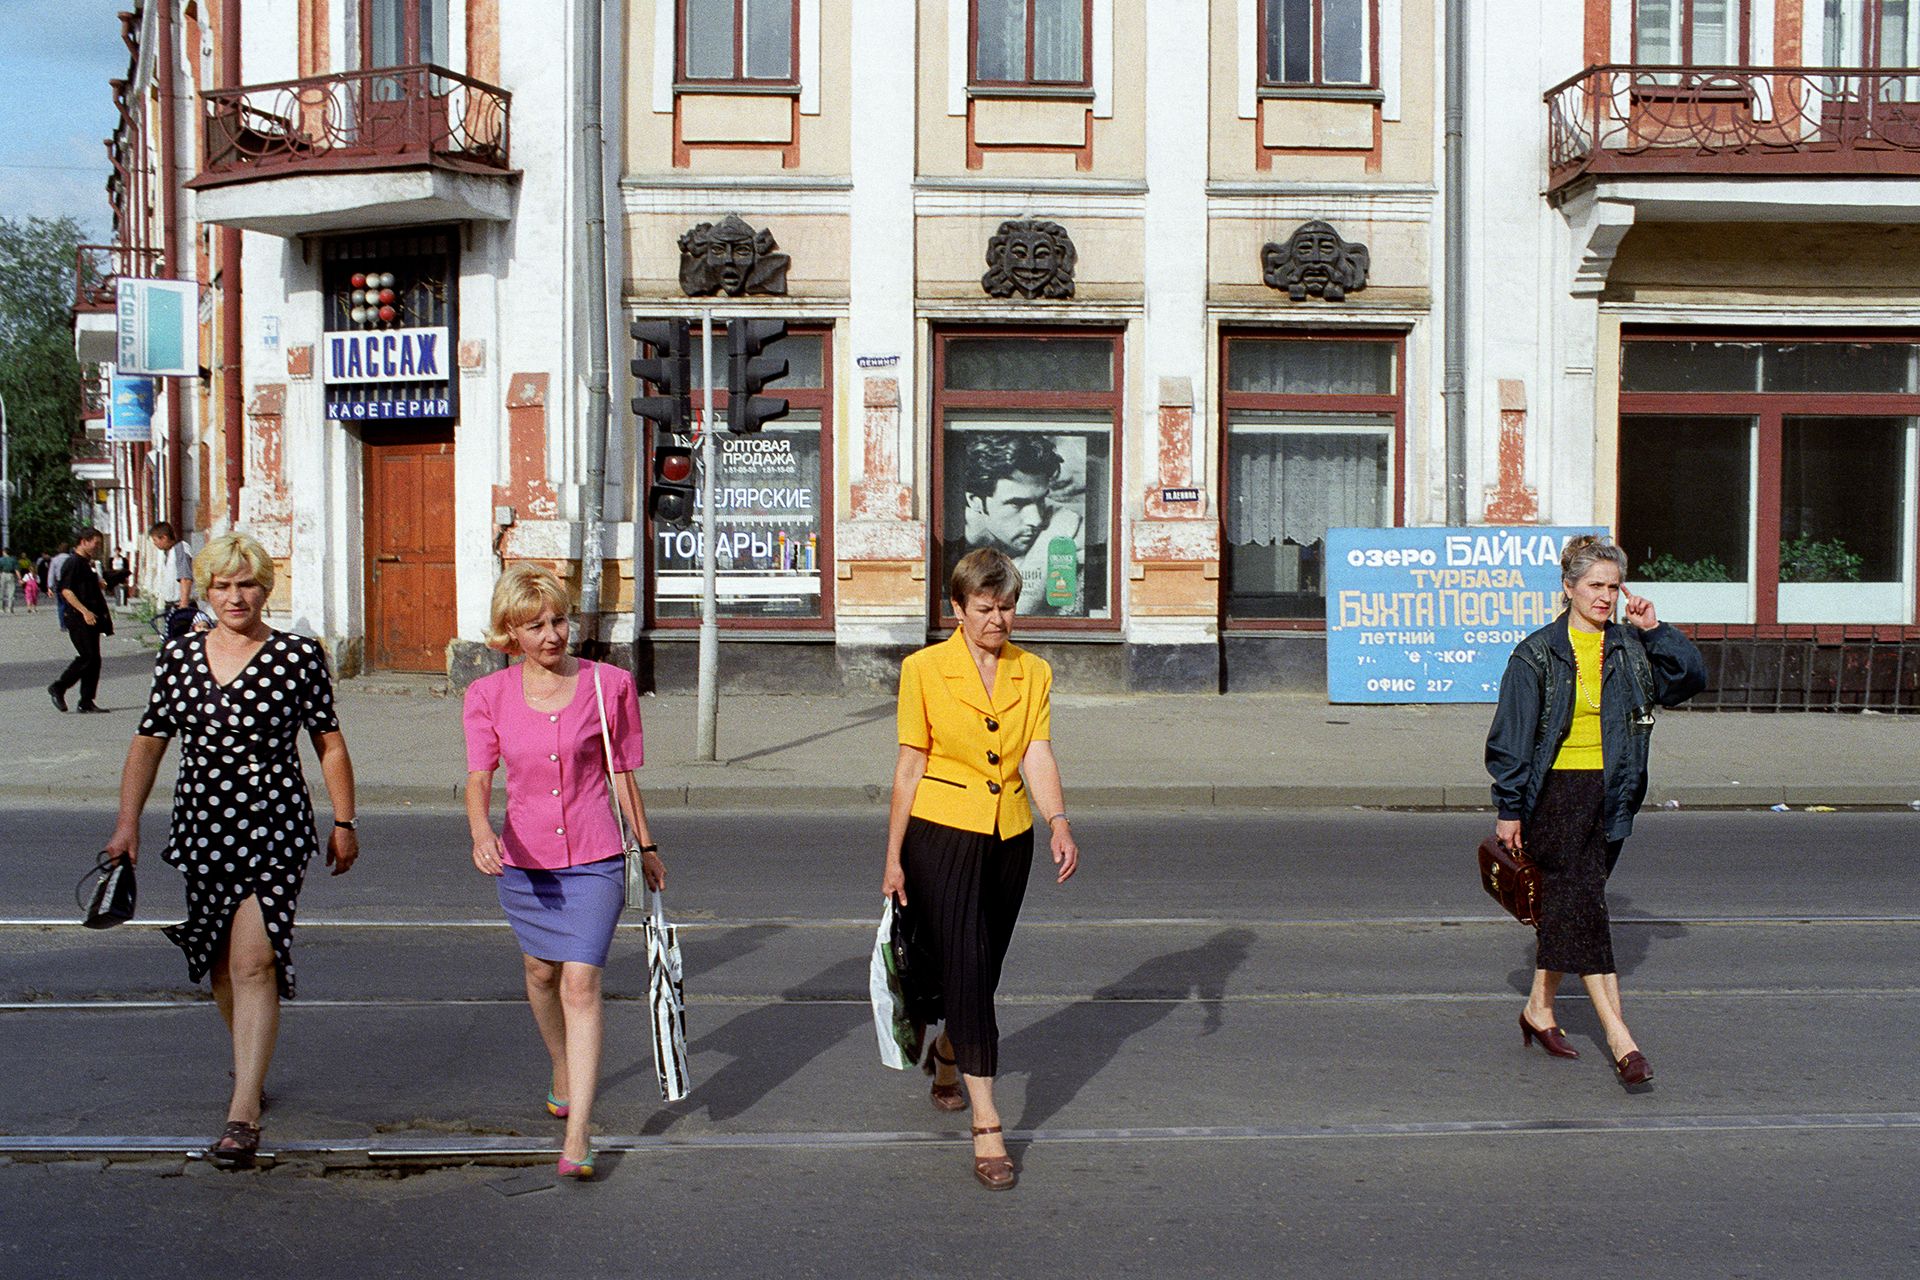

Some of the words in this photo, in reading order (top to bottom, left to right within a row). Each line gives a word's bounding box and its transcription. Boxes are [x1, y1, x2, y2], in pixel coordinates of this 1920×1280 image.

[121, 283, 136, 368] ДВЕРИ
[332, 333, 438, 378] ПАССАЖ
[328, 400, 449, 418] КАФЕТЕРИЙ
[723, 440, 790, 453] ОПТОВАЯ
[723, 453, 796, 466] ПРОДАЖА
[1347, 548, 1437, 567] озеро
[1410, 569, 1525, 589] ТУРБАЗА
[1359, 630, 1435, 645] летний
[1427, 679, 1454, 692] 217
